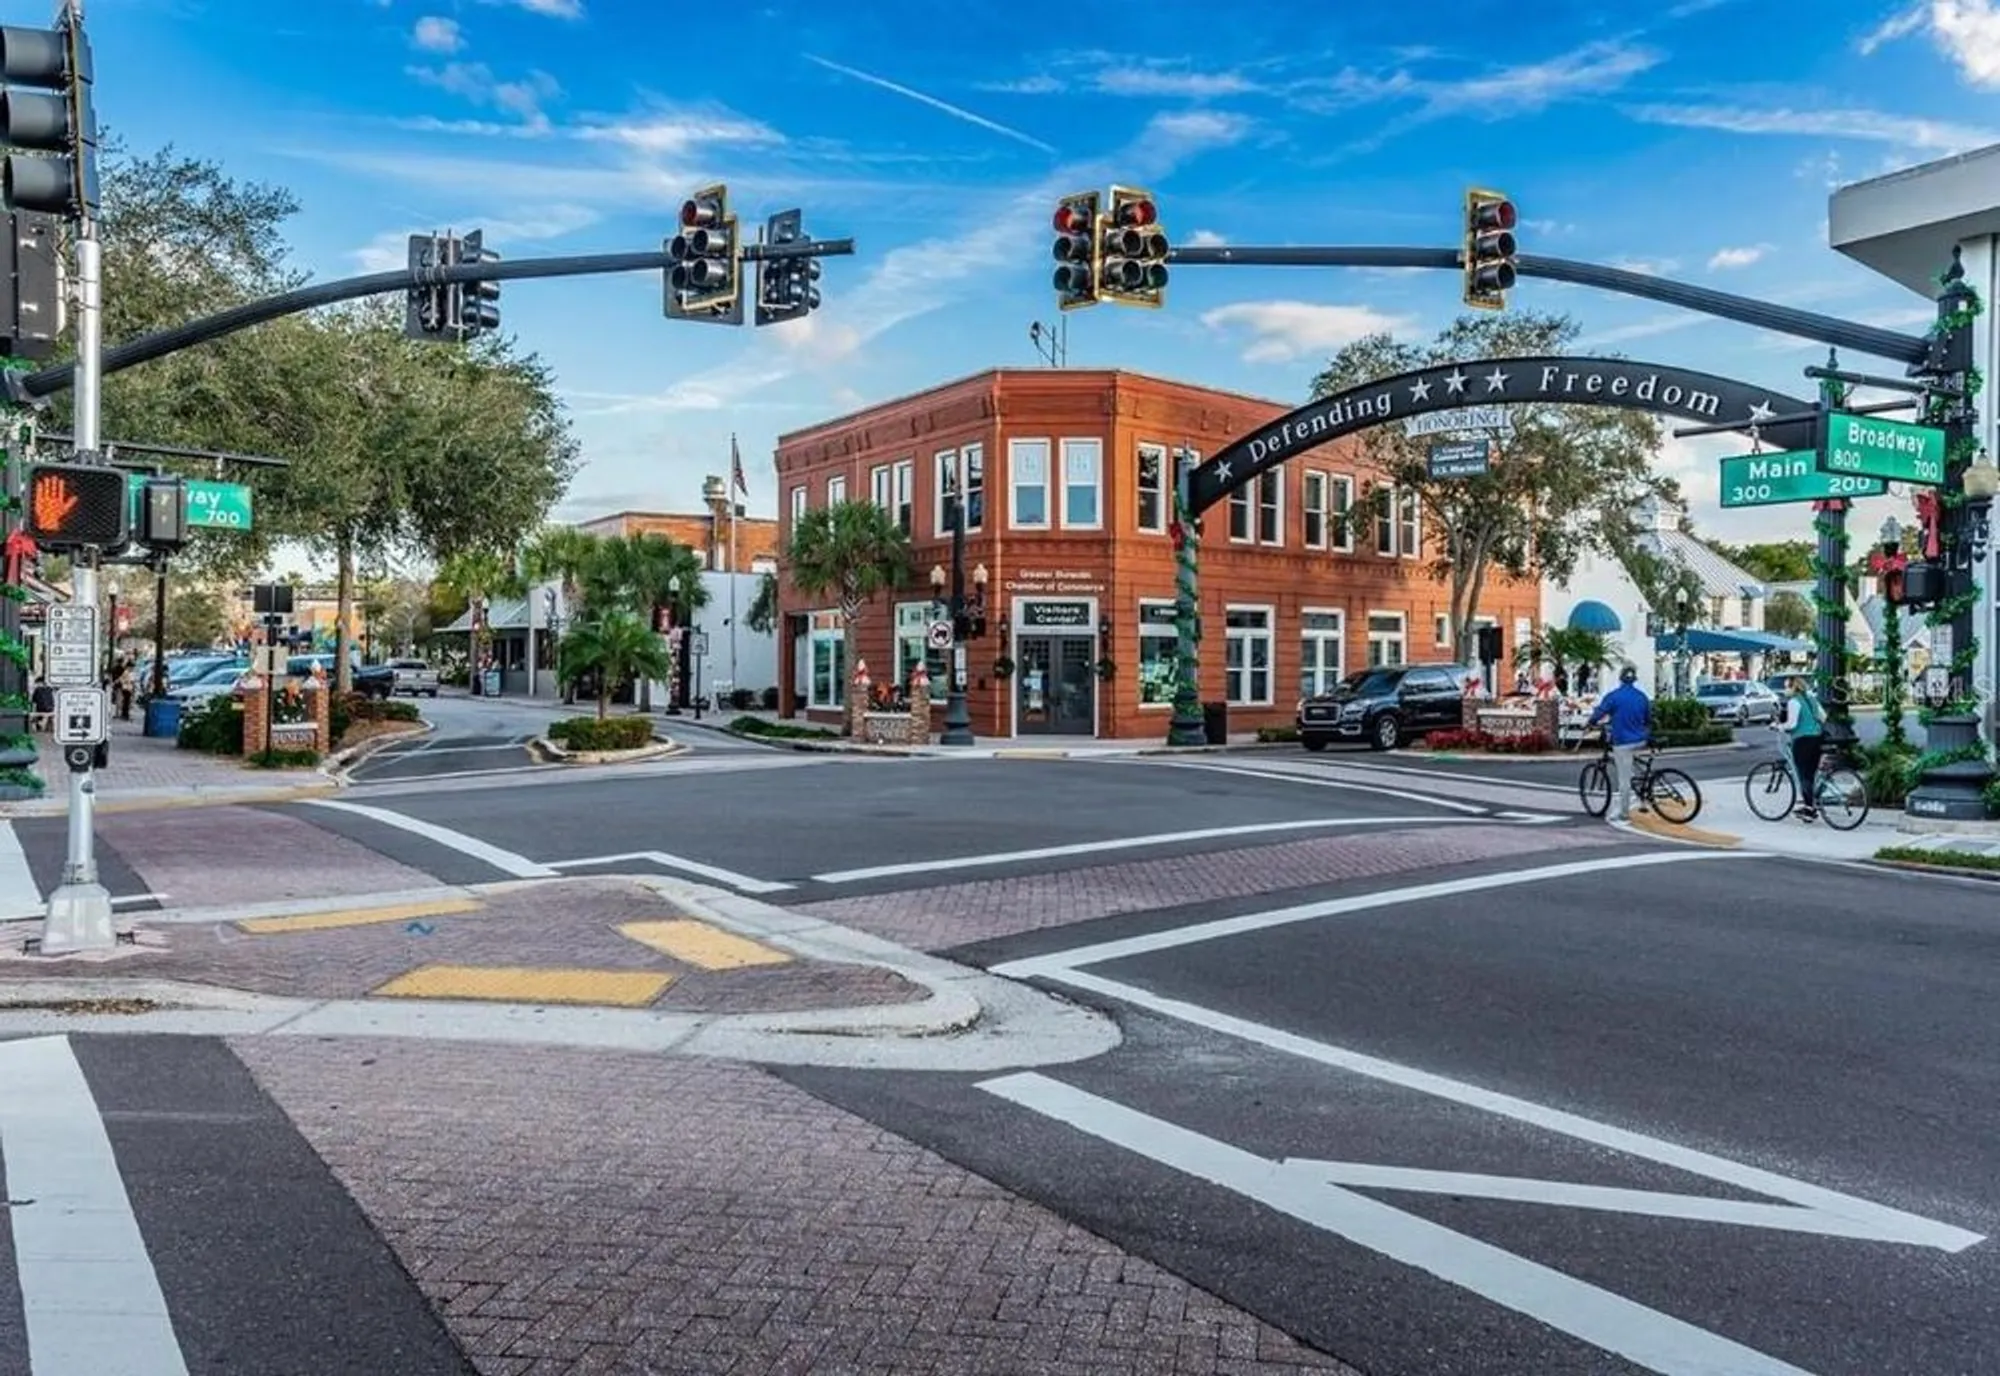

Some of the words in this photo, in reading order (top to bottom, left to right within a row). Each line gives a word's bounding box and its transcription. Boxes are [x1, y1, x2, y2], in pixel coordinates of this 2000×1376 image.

[1248, 392, 1392, 463] Defending
[1539, 366, 1720, 416] Freedom
[1416, 409, 1498, 433] HONORING
[1849, 423, 1926, 457] Broadway
[1750, 458, 1807, 480] Main
[1833, 451, 1861, 469] 800
[1914, 460, 1938, 479] 700
[1732, 485, 1771, 501] 300
[1828, 477, 1871, 493] 200
[205, 509, 240, 524] 700
[1033, 605, 1080, 614] Visitors
[1036, 614, 1077, 623] Center
